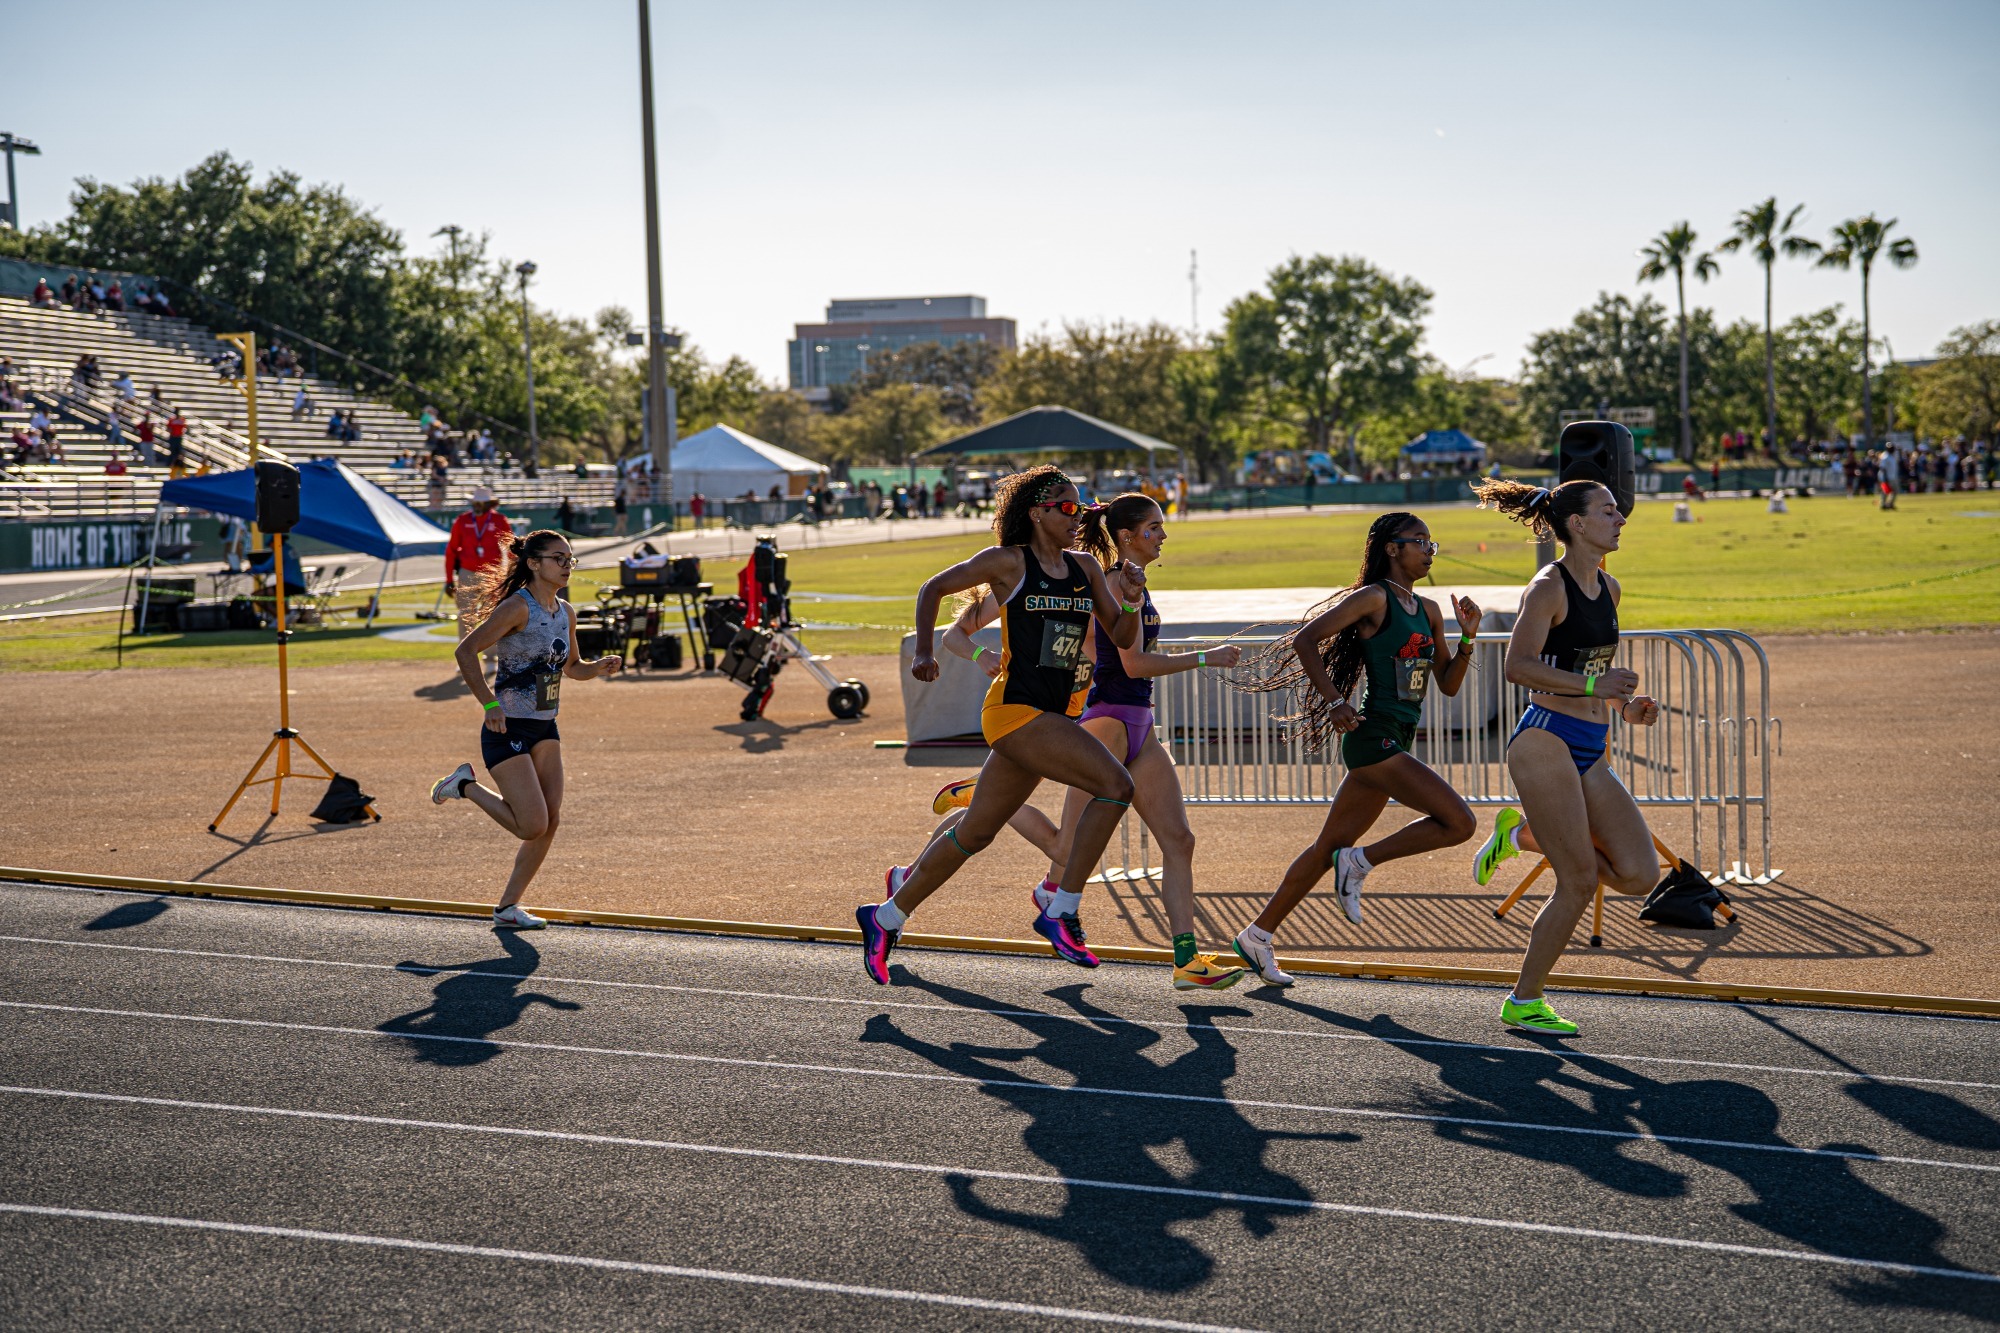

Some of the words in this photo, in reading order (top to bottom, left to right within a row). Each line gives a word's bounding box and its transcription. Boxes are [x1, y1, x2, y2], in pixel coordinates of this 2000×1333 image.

[32, 526, 82, 567] HOME
[87, 525, 108, 566] OF
[1025, 595, 1072, 611] SAINT
[1073, 598, 1093, 614] LE
[1051, 636, 1080, 658] 474
[1410, 670, 1424, 690] 85
